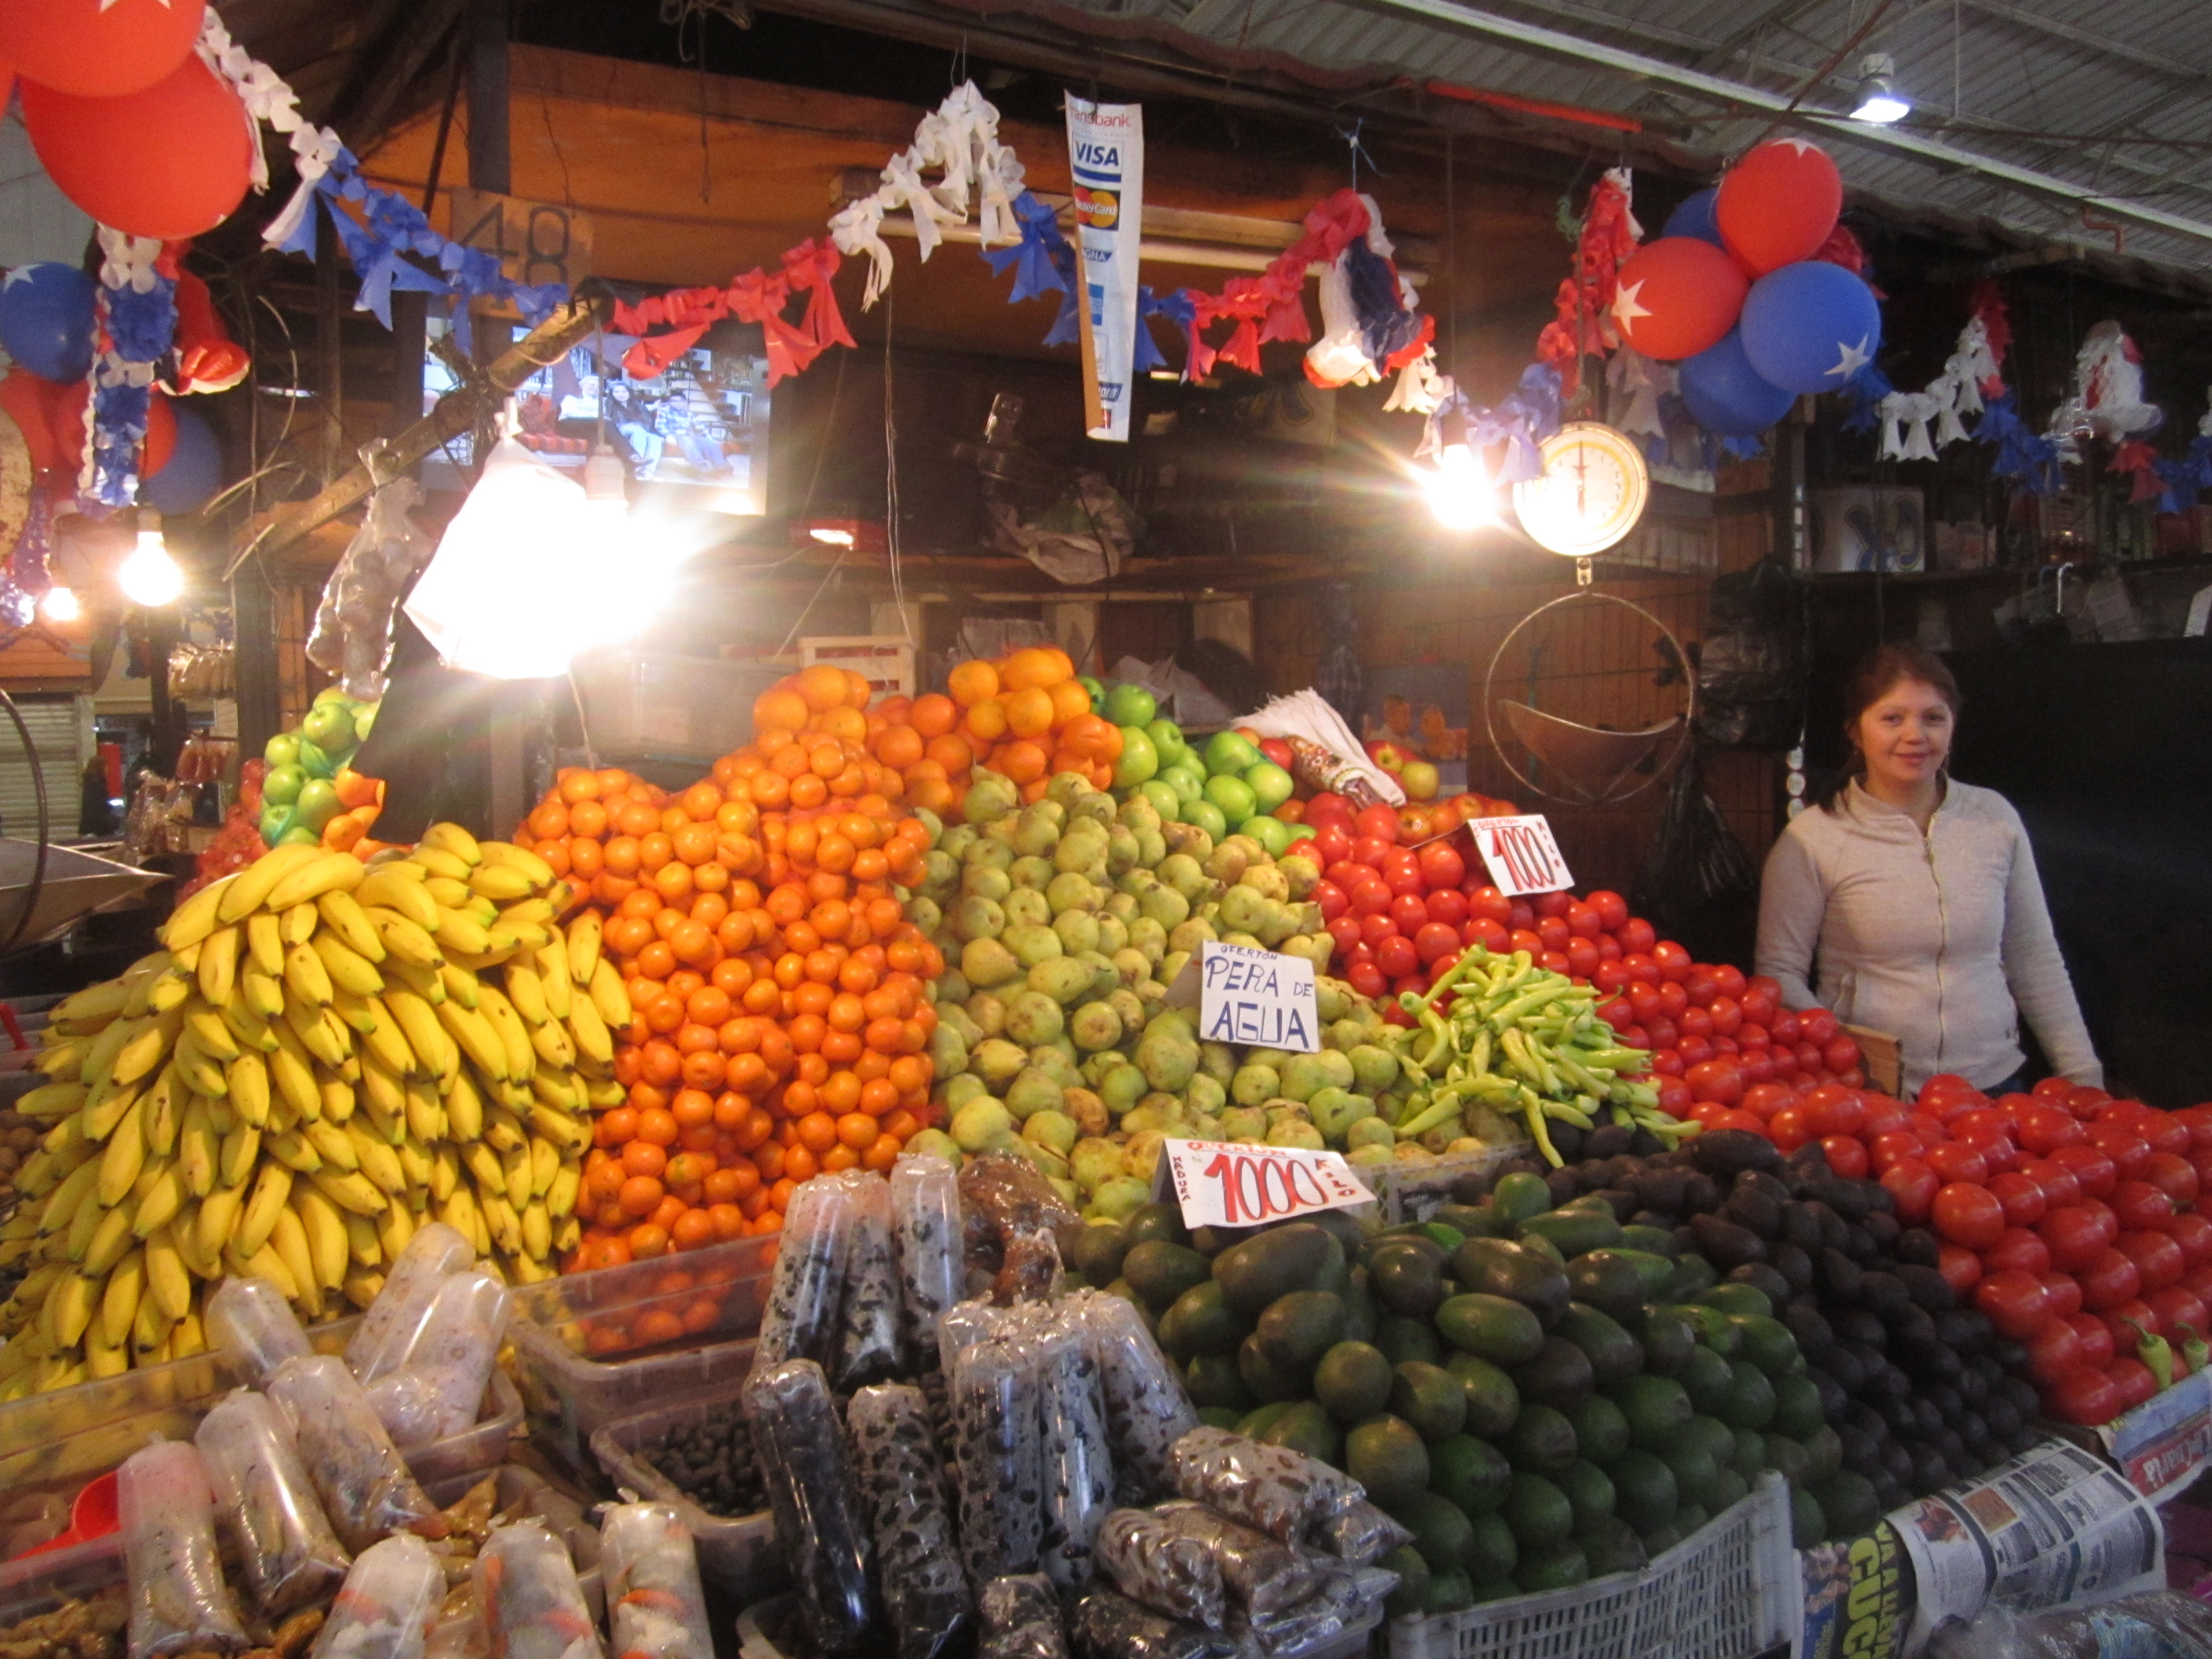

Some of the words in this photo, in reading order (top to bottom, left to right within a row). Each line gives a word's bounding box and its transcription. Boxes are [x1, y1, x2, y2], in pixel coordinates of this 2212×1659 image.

[1076, 141, 1119, 167] VISA
[459, 200, 570, 305] 48
[1492, 826, 1556, 891] 1000
[1204, 955, 1279, 997] PERA
[1293, 982, 1313, 997] DE
[1209, 1001, 1310, 1049] AGUA
[1172, 1156, 1191, 1201] MADURA
[1203, 1153, 1329, 1223] 1000
